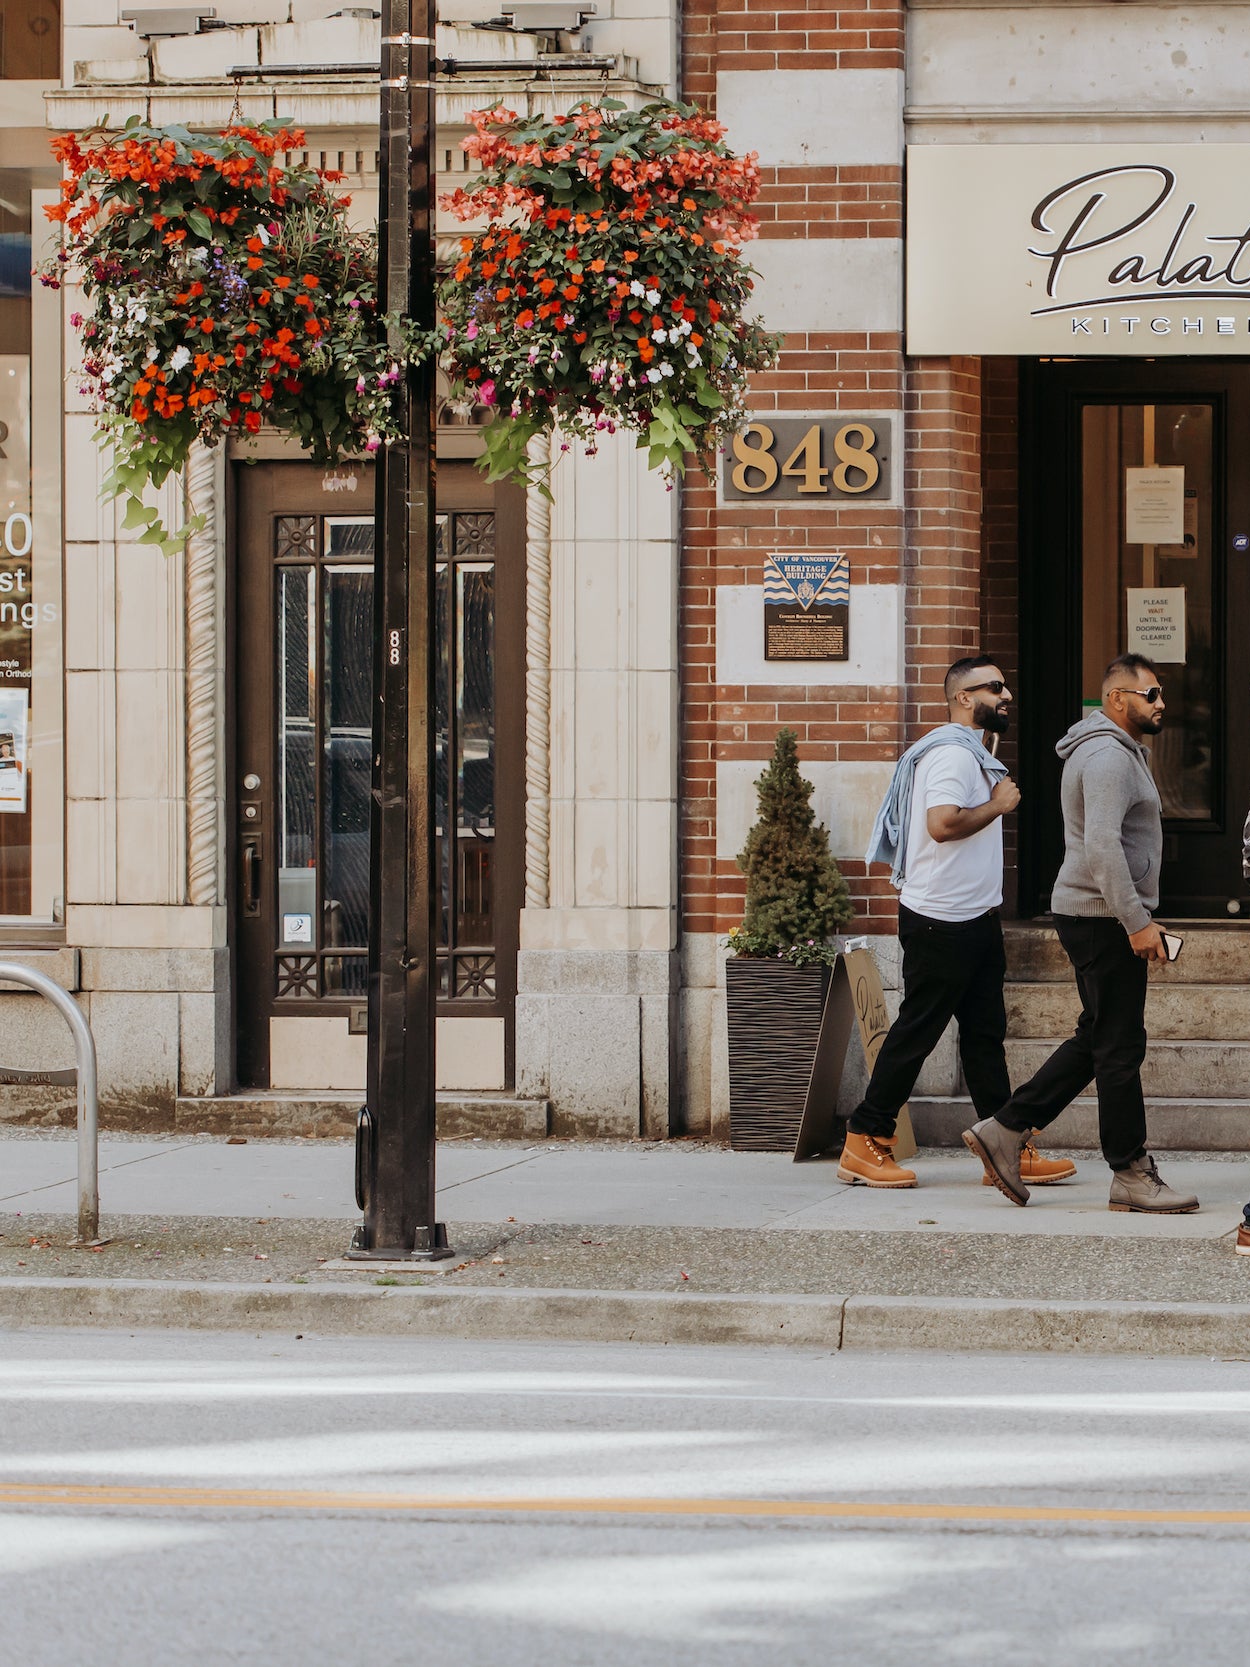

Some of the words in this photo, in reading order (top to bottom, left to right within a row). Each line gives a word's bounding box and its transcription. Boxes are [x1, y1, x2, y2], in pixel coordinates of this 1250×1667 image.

[731, 423, 879, 494] 848
[0, 512, 33, 557] 0
[784, 565, 827, 573] HERITAGE
[786, 572, 826, 580] BUILDING
